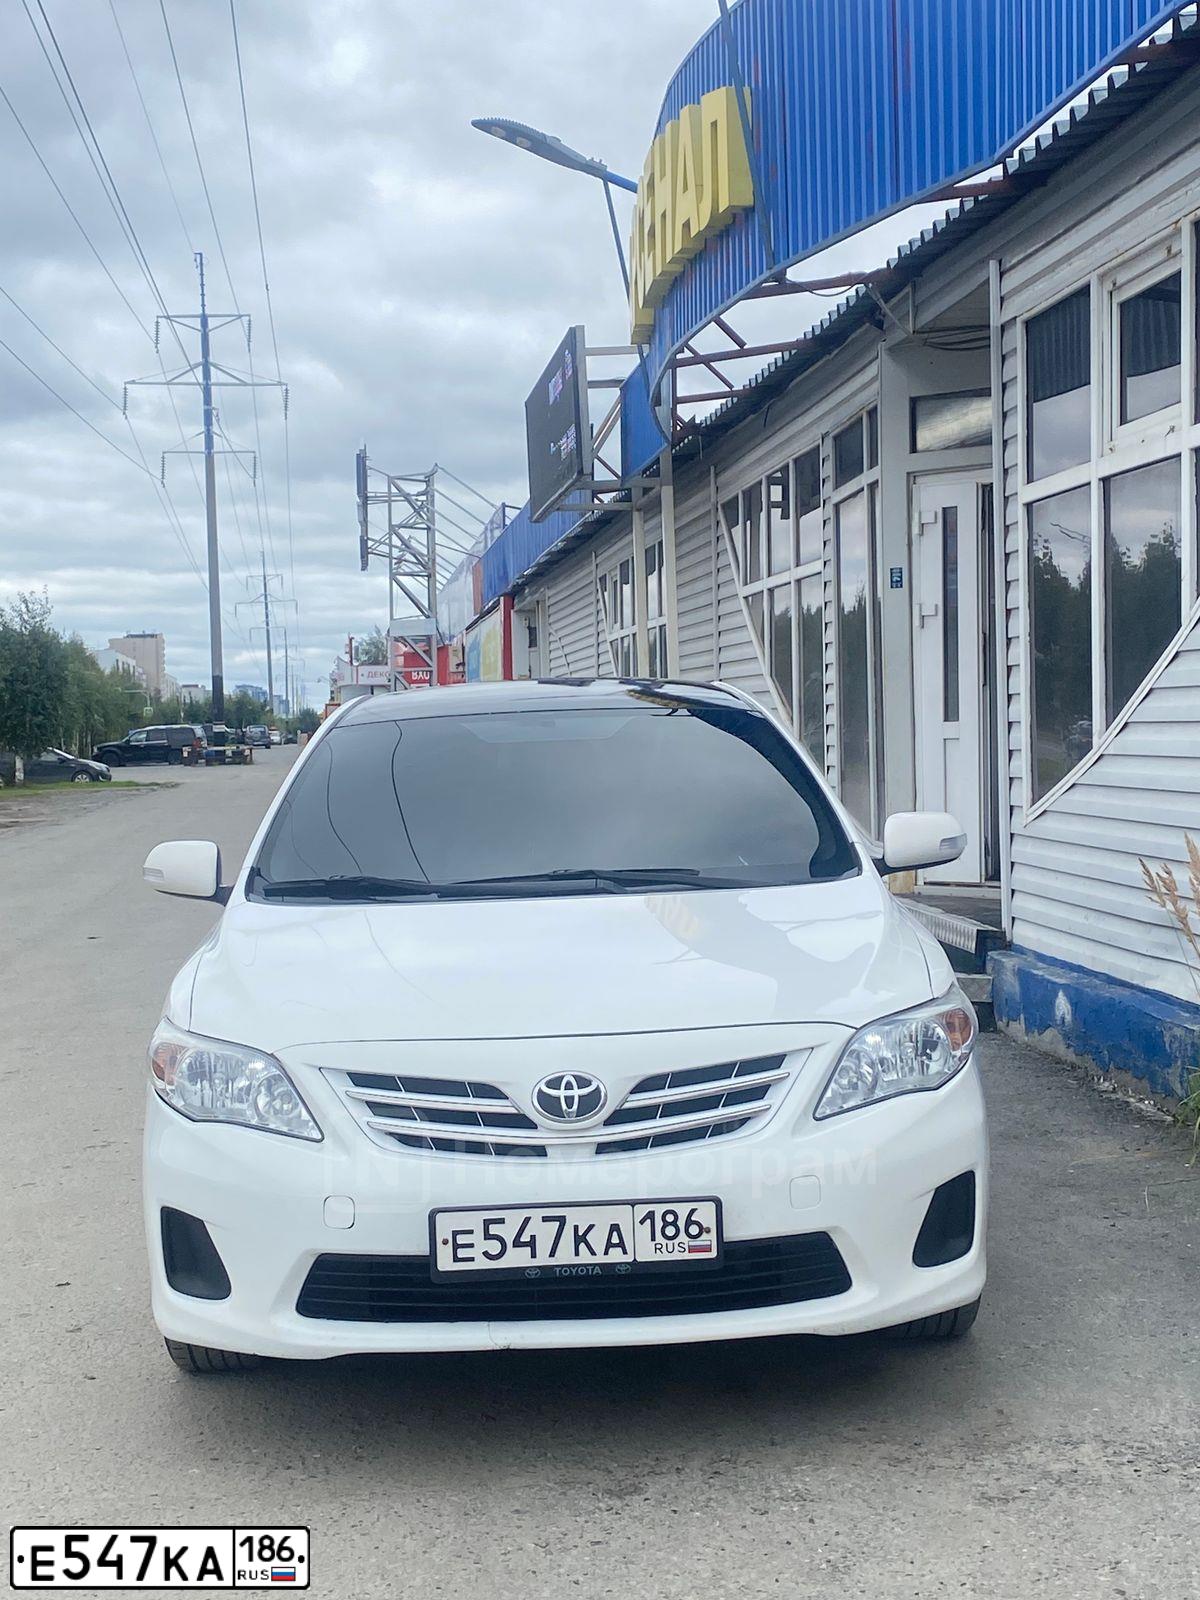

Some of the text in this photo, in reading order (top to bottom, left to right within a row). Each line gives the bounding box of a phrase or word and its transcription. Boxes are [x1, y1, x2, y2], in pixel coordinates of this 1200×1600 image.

[629, 86, 754, 345] СЕНАЛ
[451, 1207, 704, 1263] Е547КА 186
[653, 1241, 686, 1255] RUS
[553, 1264, 602, 1276] TOYOTA
